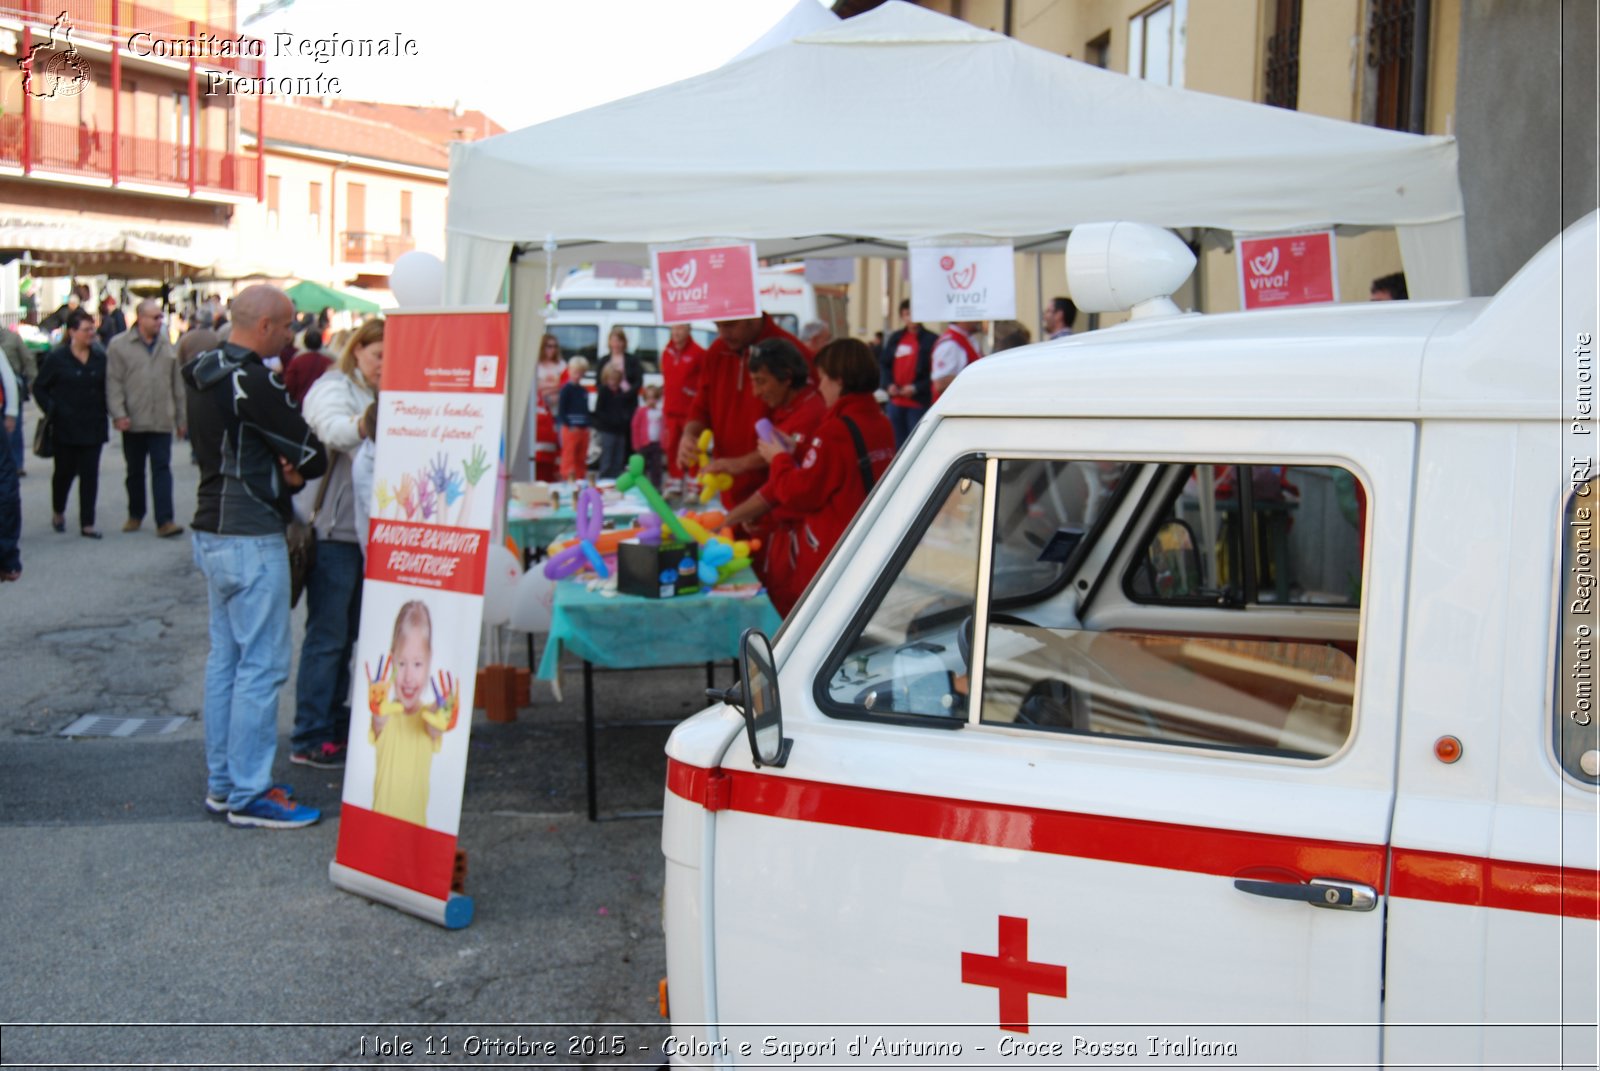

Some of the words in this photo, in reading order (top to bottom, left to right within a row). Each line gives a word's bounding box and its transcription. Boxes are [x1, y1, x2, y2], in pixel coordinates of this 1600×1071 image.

[1249, 269, 1290, 290] viva!
[946, 287, 987, 305] viva!
[371, 522, 424, 547] MANOVRE
[420, 528, 481, 555] SALVAVITA
[386, 549, 460, 577] PEDIATRICHE
